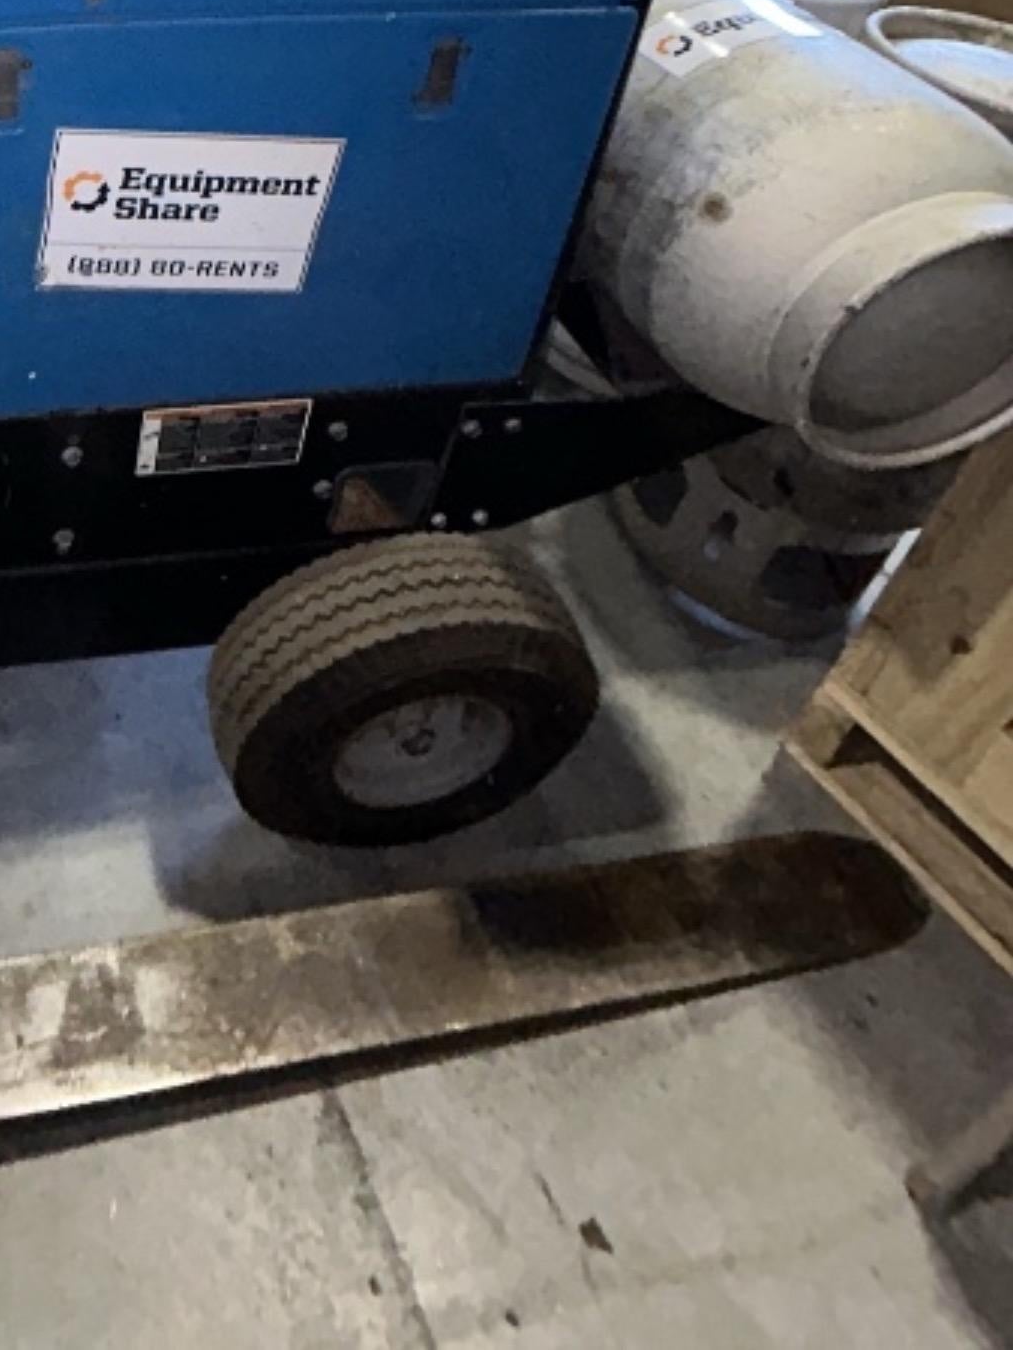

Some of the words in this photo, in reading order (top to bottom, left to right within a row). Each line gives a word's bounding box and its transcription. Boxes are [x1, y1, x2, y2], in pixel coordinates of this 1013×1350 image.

[119, 166, 321, 199] Equipment
[113, 197, 221, 223] Share
[150, 258, 281, 279] 80-RENTS
